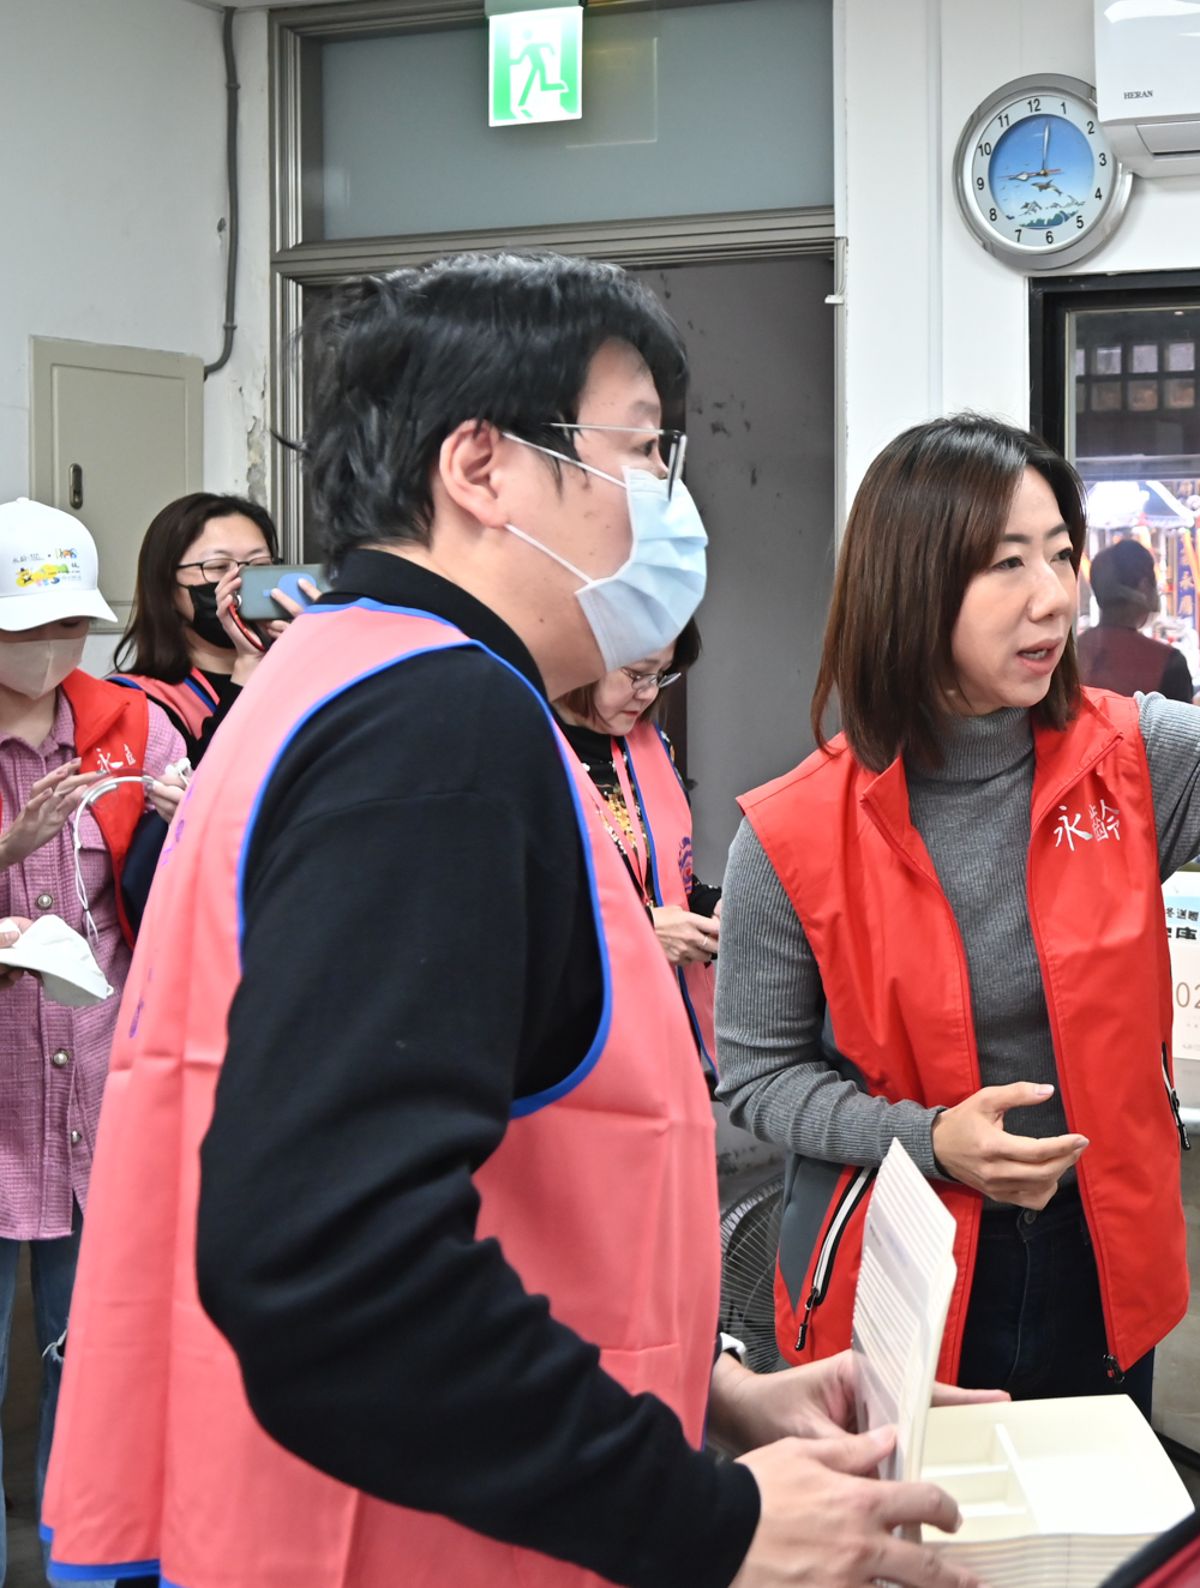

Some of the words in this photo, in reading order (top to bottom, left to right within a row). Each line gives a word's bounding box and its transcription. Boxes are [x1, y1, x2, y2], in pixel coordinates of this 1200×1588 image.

[1123, 90, 1153, 99] HERAN
[1027, 98, 1041, 113] 12
[1060, 102, 1067, 114] 1
[998, 114, 1010, 127] 11
[1086, 121, 1094, 134] 2
[978, 142, 992, 156] 10
[1099, 153, 1107, 166] 3
[977, 177, 985, 190] 9
[1094, 188, 1102, 200] 4
[989, 208, 998, 222] 8
[1076, 215, 1085, 229] 5
[1014, 229, 1022, 243] 7
[1045, 231, 1054, 244] 6
[1053, 799, 1120, 851] 永齡
